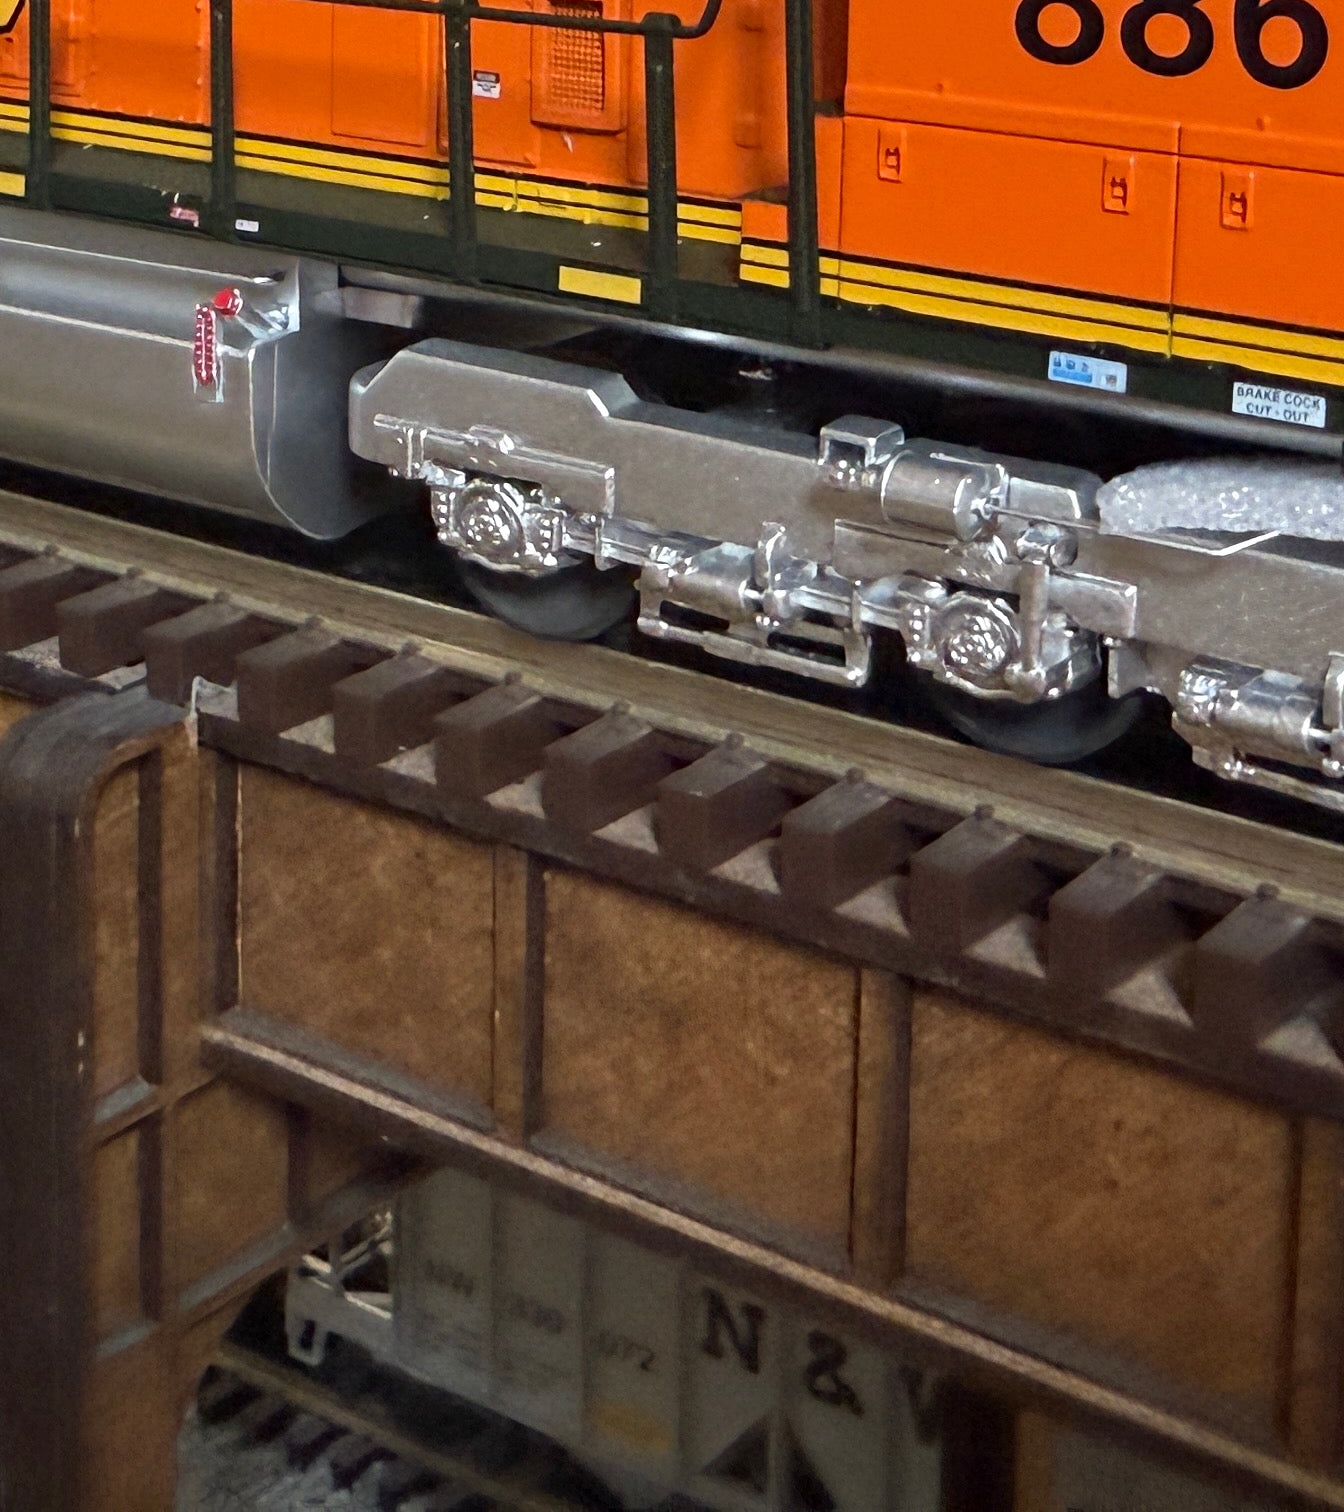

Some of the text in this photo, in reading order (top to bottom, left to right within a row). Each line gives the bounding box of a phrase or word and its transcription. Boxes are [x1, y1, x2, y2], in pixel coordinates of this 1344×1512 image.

[1237, 386, 1321, 411] BRAKE COCK
[703, 1287, 766, 1375] N
